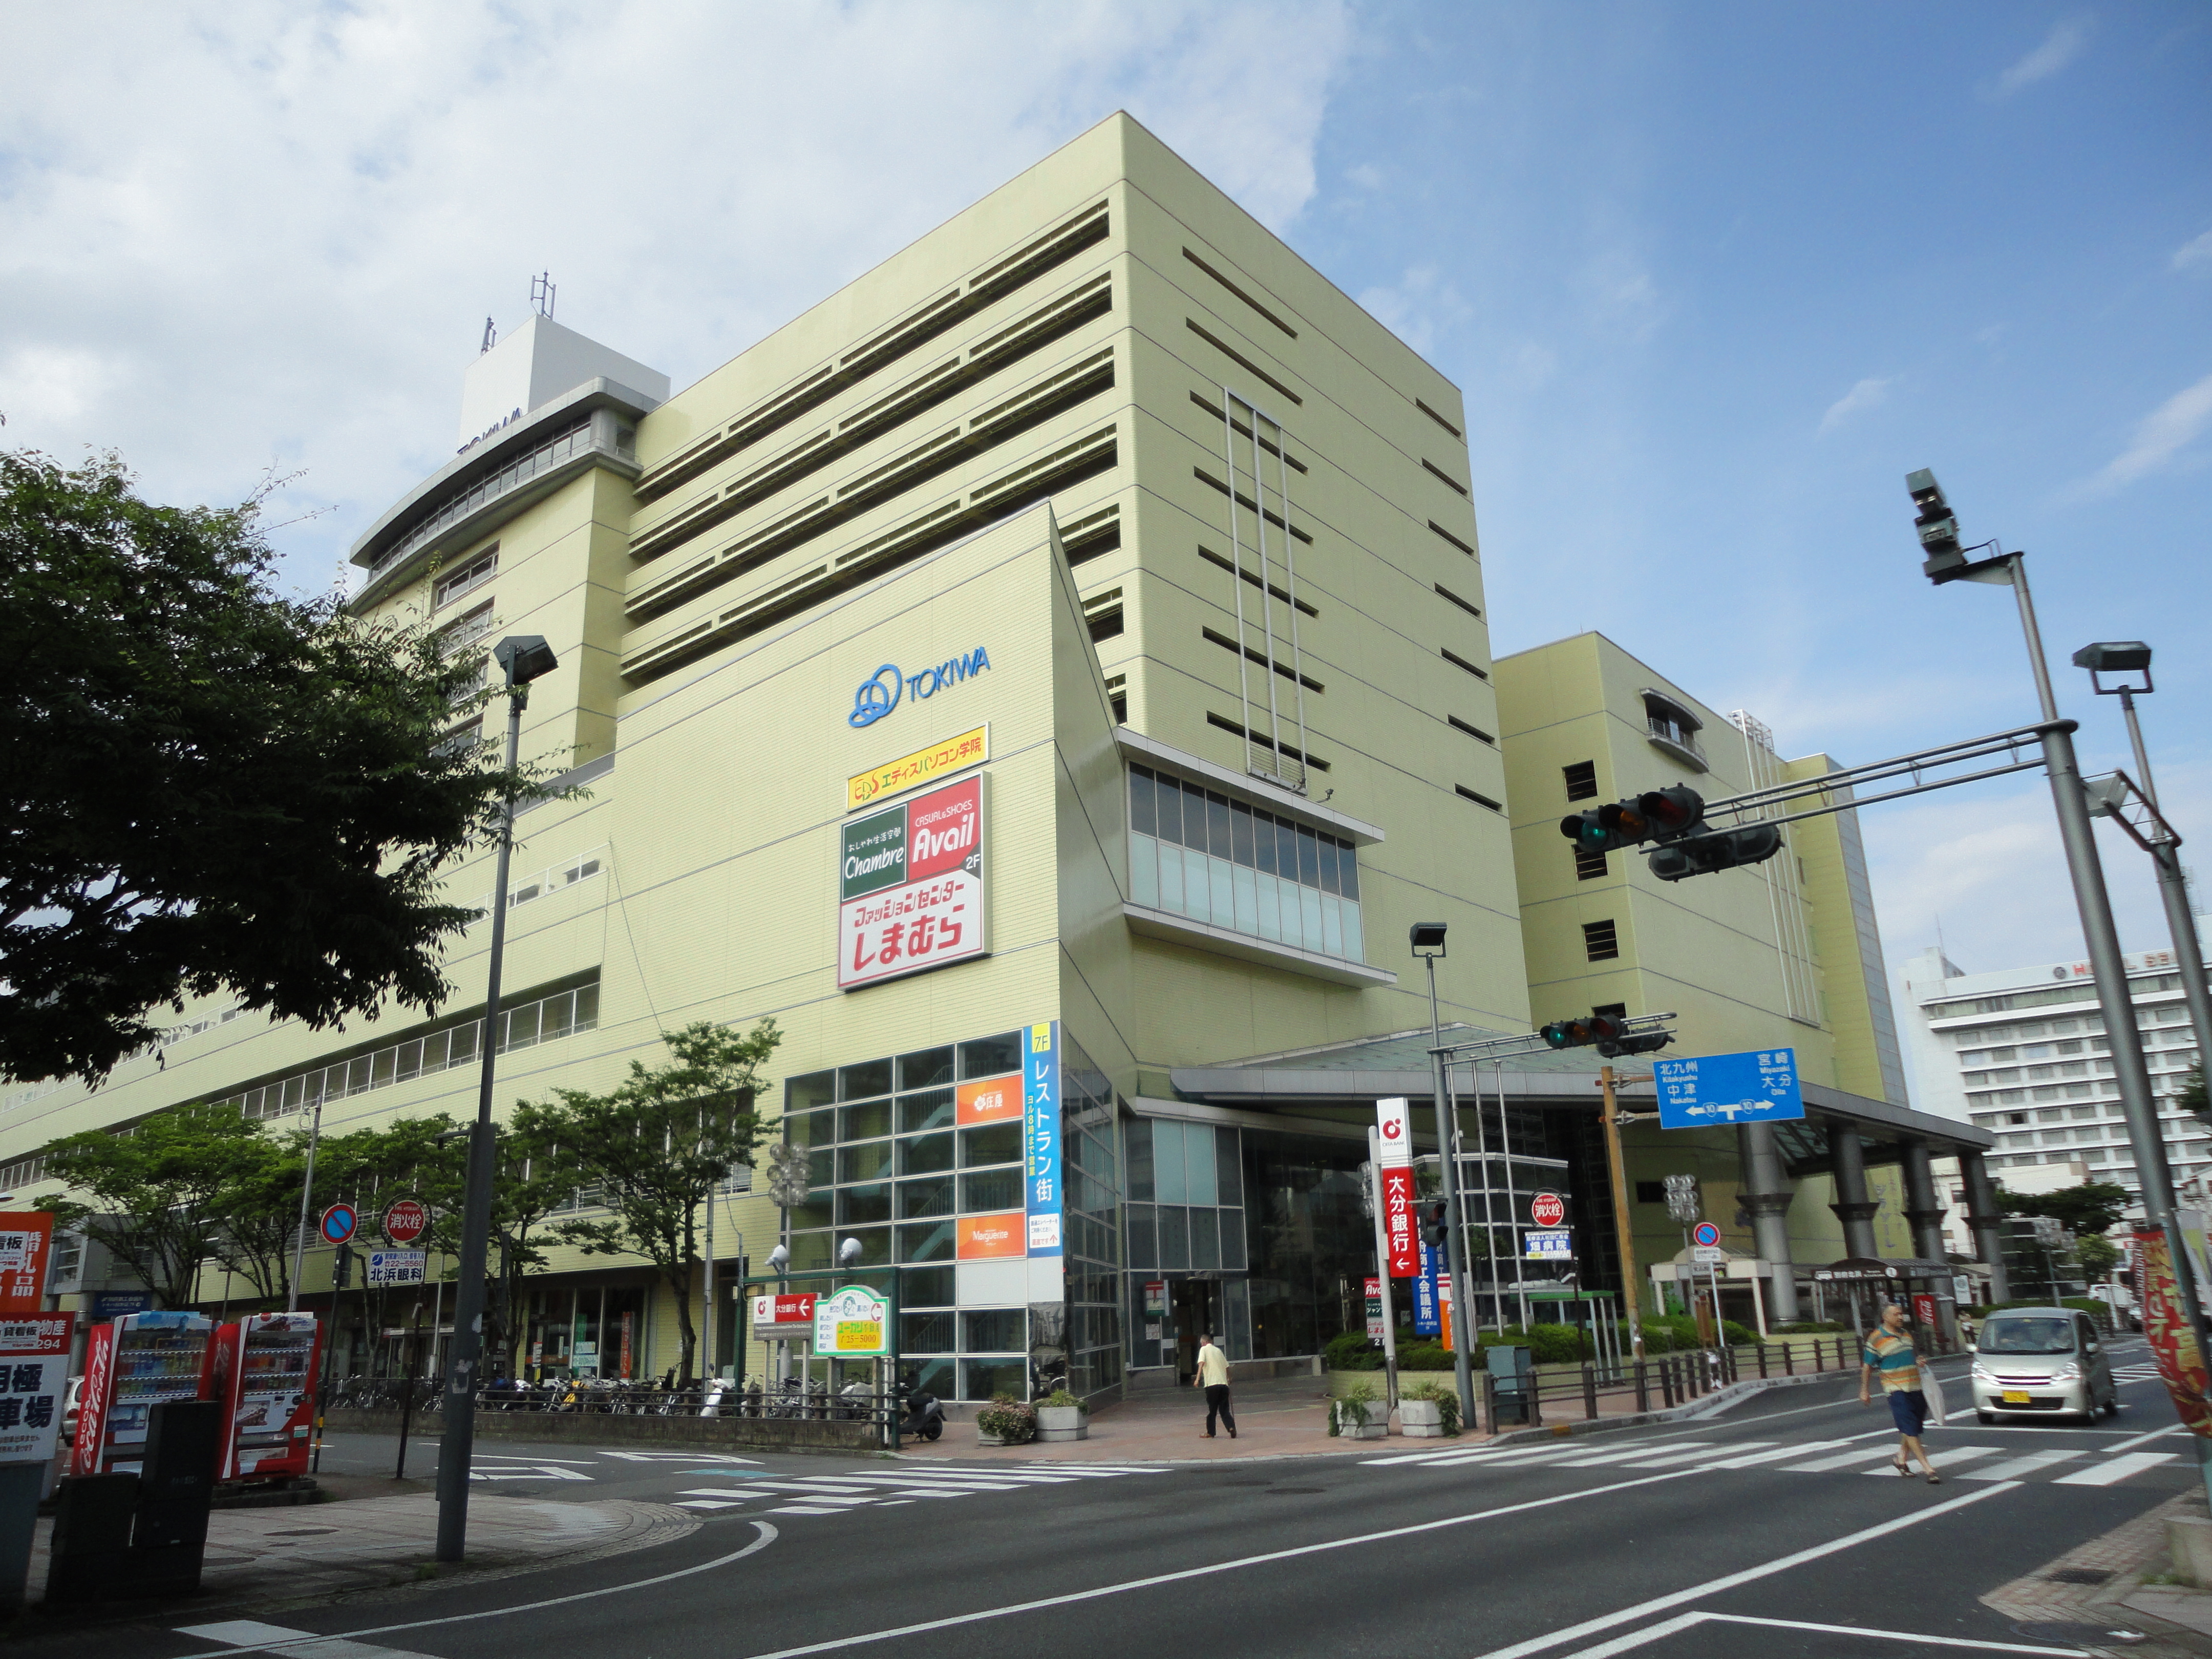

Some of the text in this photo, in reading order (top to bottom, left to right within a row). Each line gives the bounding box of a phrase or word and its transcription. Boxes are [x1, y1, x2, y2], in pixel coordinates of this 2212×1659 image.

[905, 646, 990, 702] TOKIWA
[882, 736, 982, 789] エディスパソコン学院
[915, 799, 973, 827] CASUAL&SHOES
[848, 827, 901, 852] おしゃれ生活空間
[912, 812, 975, 863] Avail
[845, 846, 904, 879] Chambre
[966, 854, 981, 870] 2F
[854, 880, 965, 927] ファッションセンター
[854, 904, 965, 971] しまむら
[1035, 1035, 1048, 1052] 7F
[1757, 1052, 1788, 1066] 宮崎
[1660, 1060, 1698, 1075] 北九州
[1761, 1074, 1792, 1088] 大分
[1668, 1083, 1696, 1098] 中津
[1706, 1104, 1715, 1113] 10
[1742, 1101, 1752, 1110] 10
[1036, 1060, 1052, 1203] レストラン街
[1389, 1176, 1409, 1252] 大分銀行
[1535, 1203, 1561, 1217] 消火栓
[390, 1213, 421, 1229] 消火栓
[973, 1230, 1008, 1242] Marguerite
[1530, 1240, 1567, 1251] 畑病院
[370, 1268, 422, 1281] 北浜眼科
[776, 1304, 796, 1313] 大分銀行
